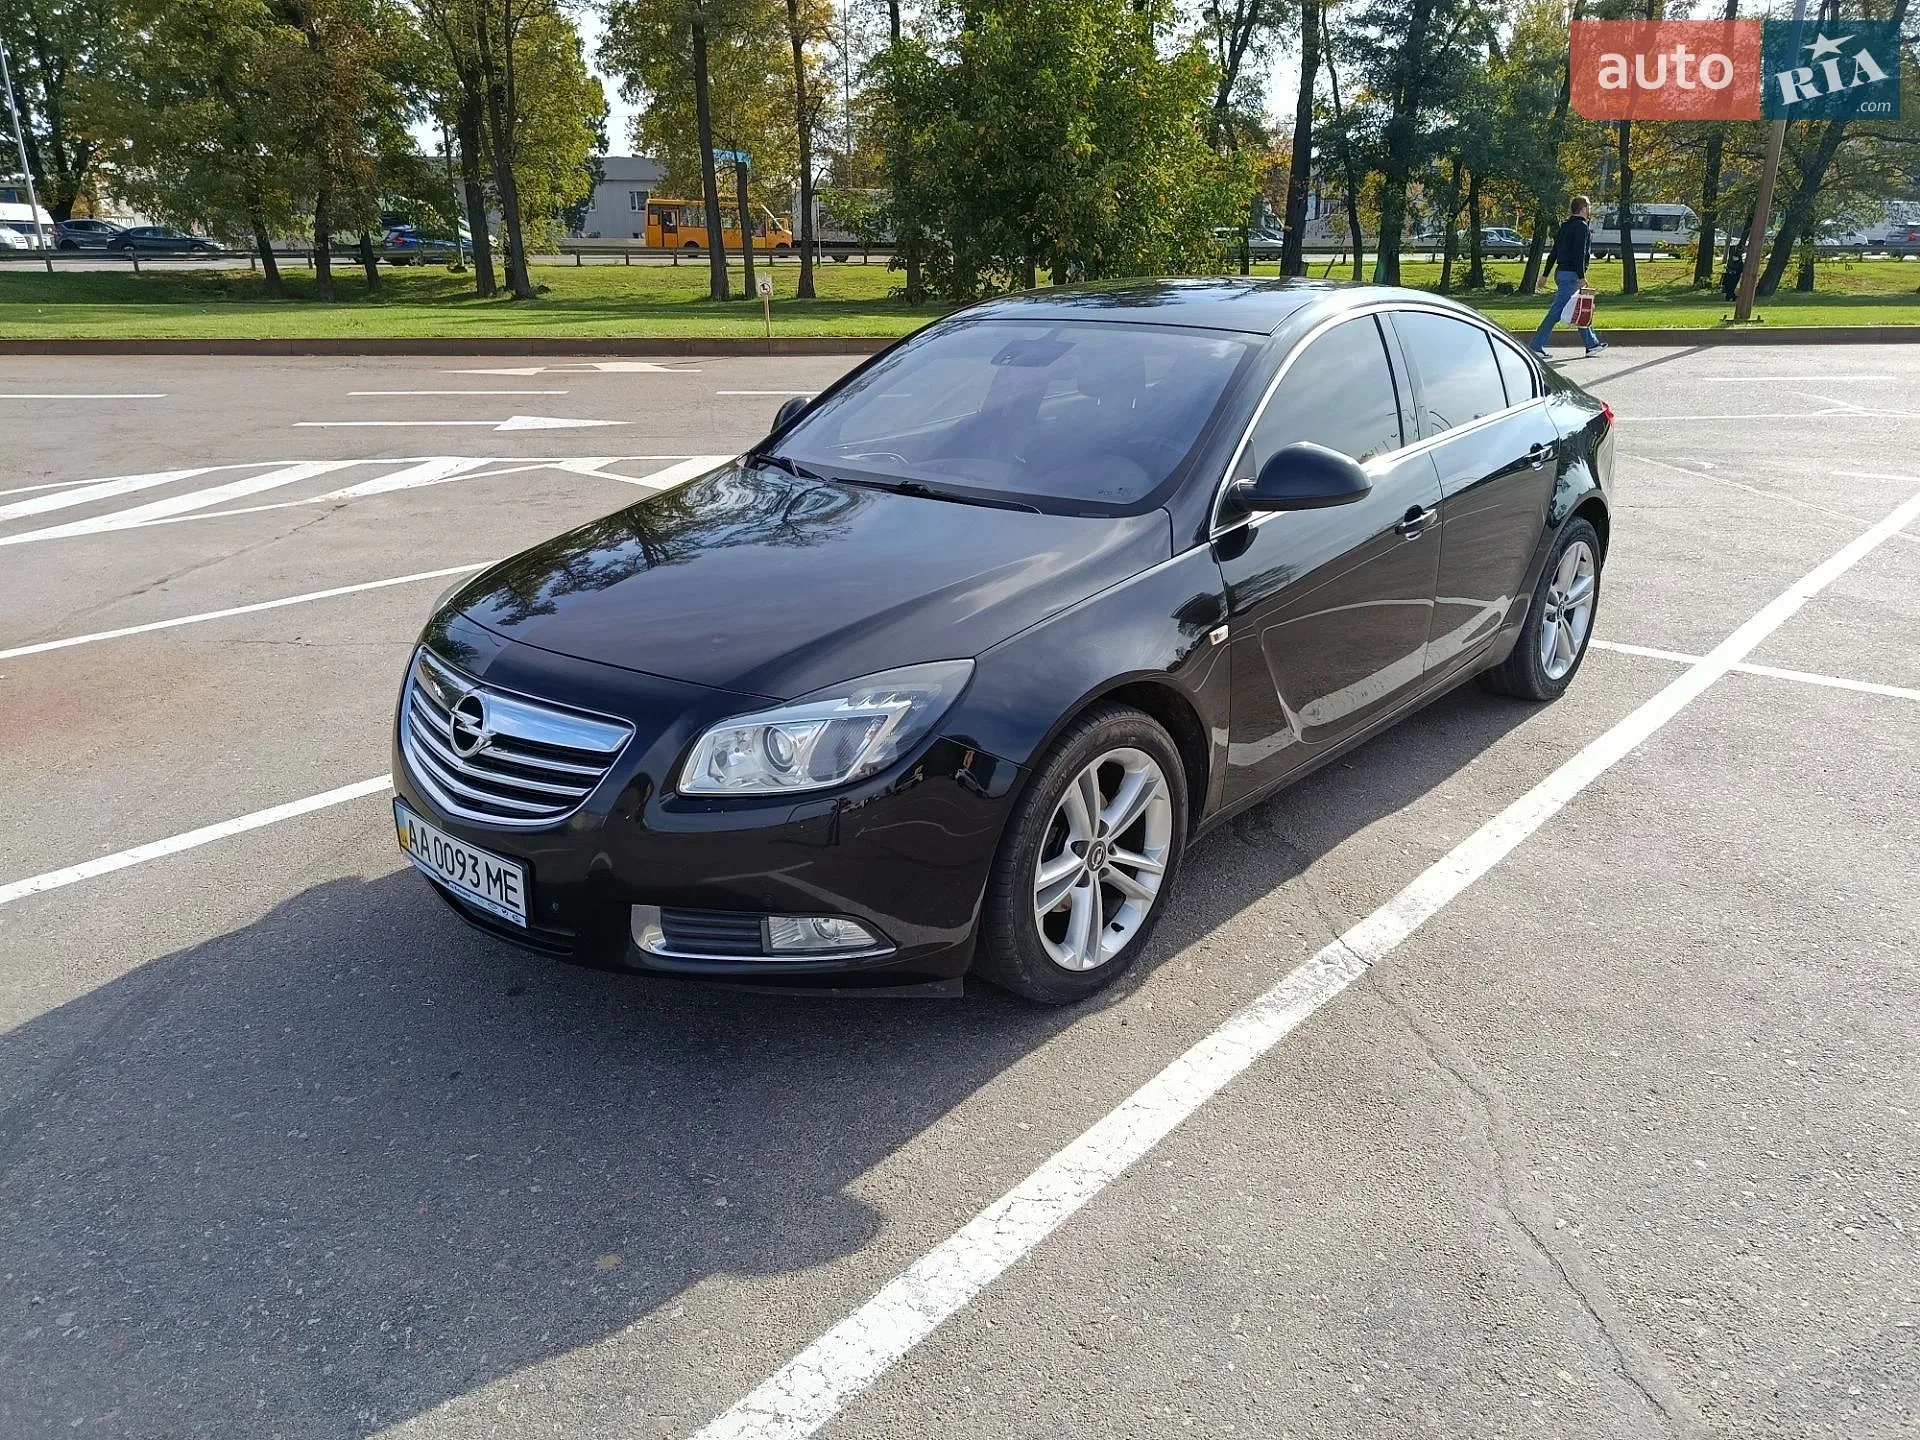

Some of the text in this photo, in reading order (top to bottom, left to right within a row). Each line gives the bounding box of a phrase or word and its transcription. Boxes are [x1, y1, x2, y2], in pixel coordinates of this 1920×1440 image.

[408, 819, 431, 862] AA
[433, 836, 480, 888] 0093
[485, 861, 520, 909] ME
